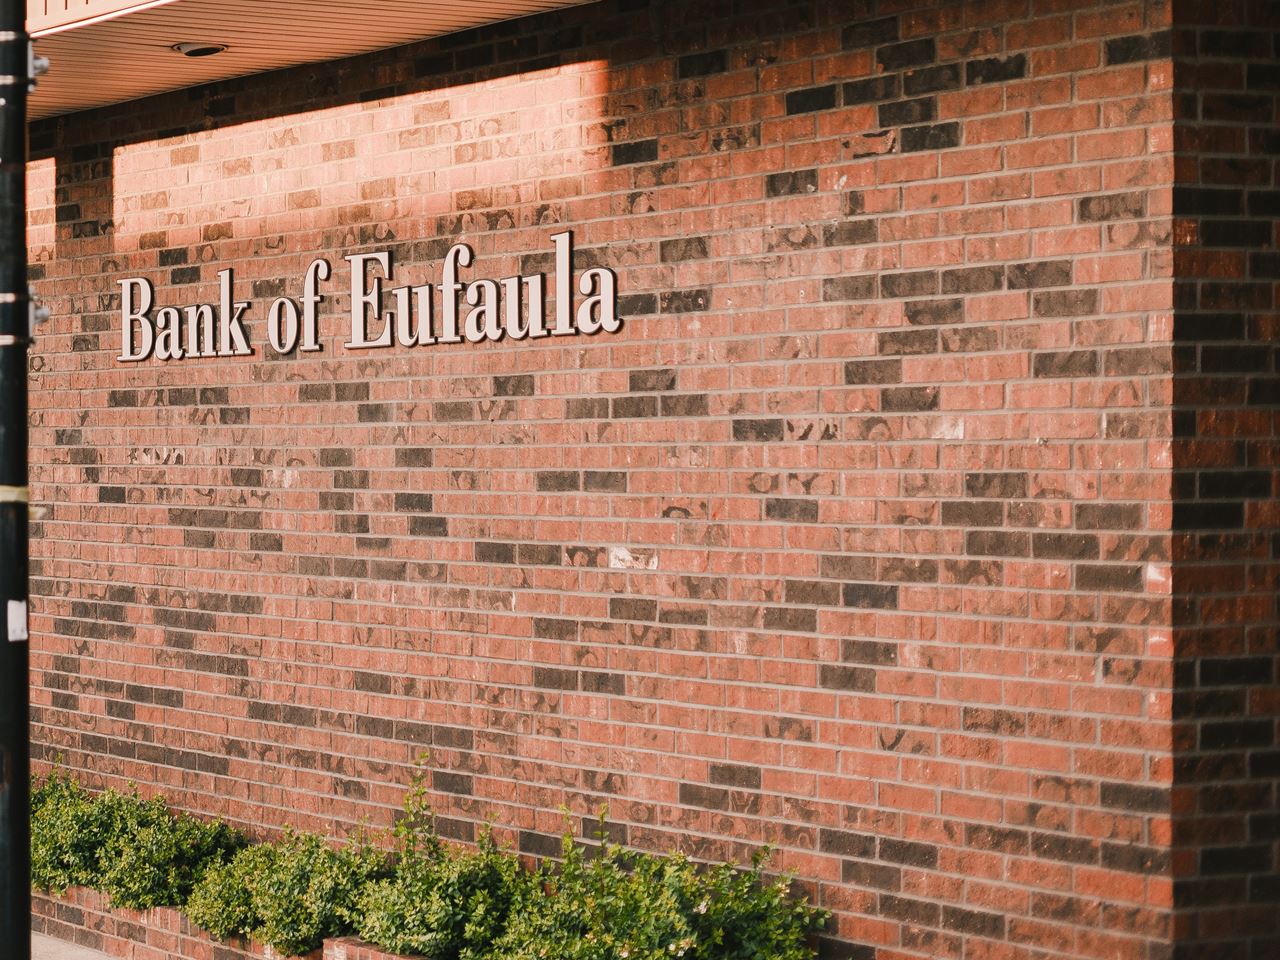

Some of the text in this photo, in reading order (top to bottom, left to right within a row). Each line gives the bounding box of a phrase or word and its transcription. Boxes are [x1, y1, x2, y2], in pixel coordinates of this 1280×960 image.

[117, 230, 624, 363] Bank of Eufaula
